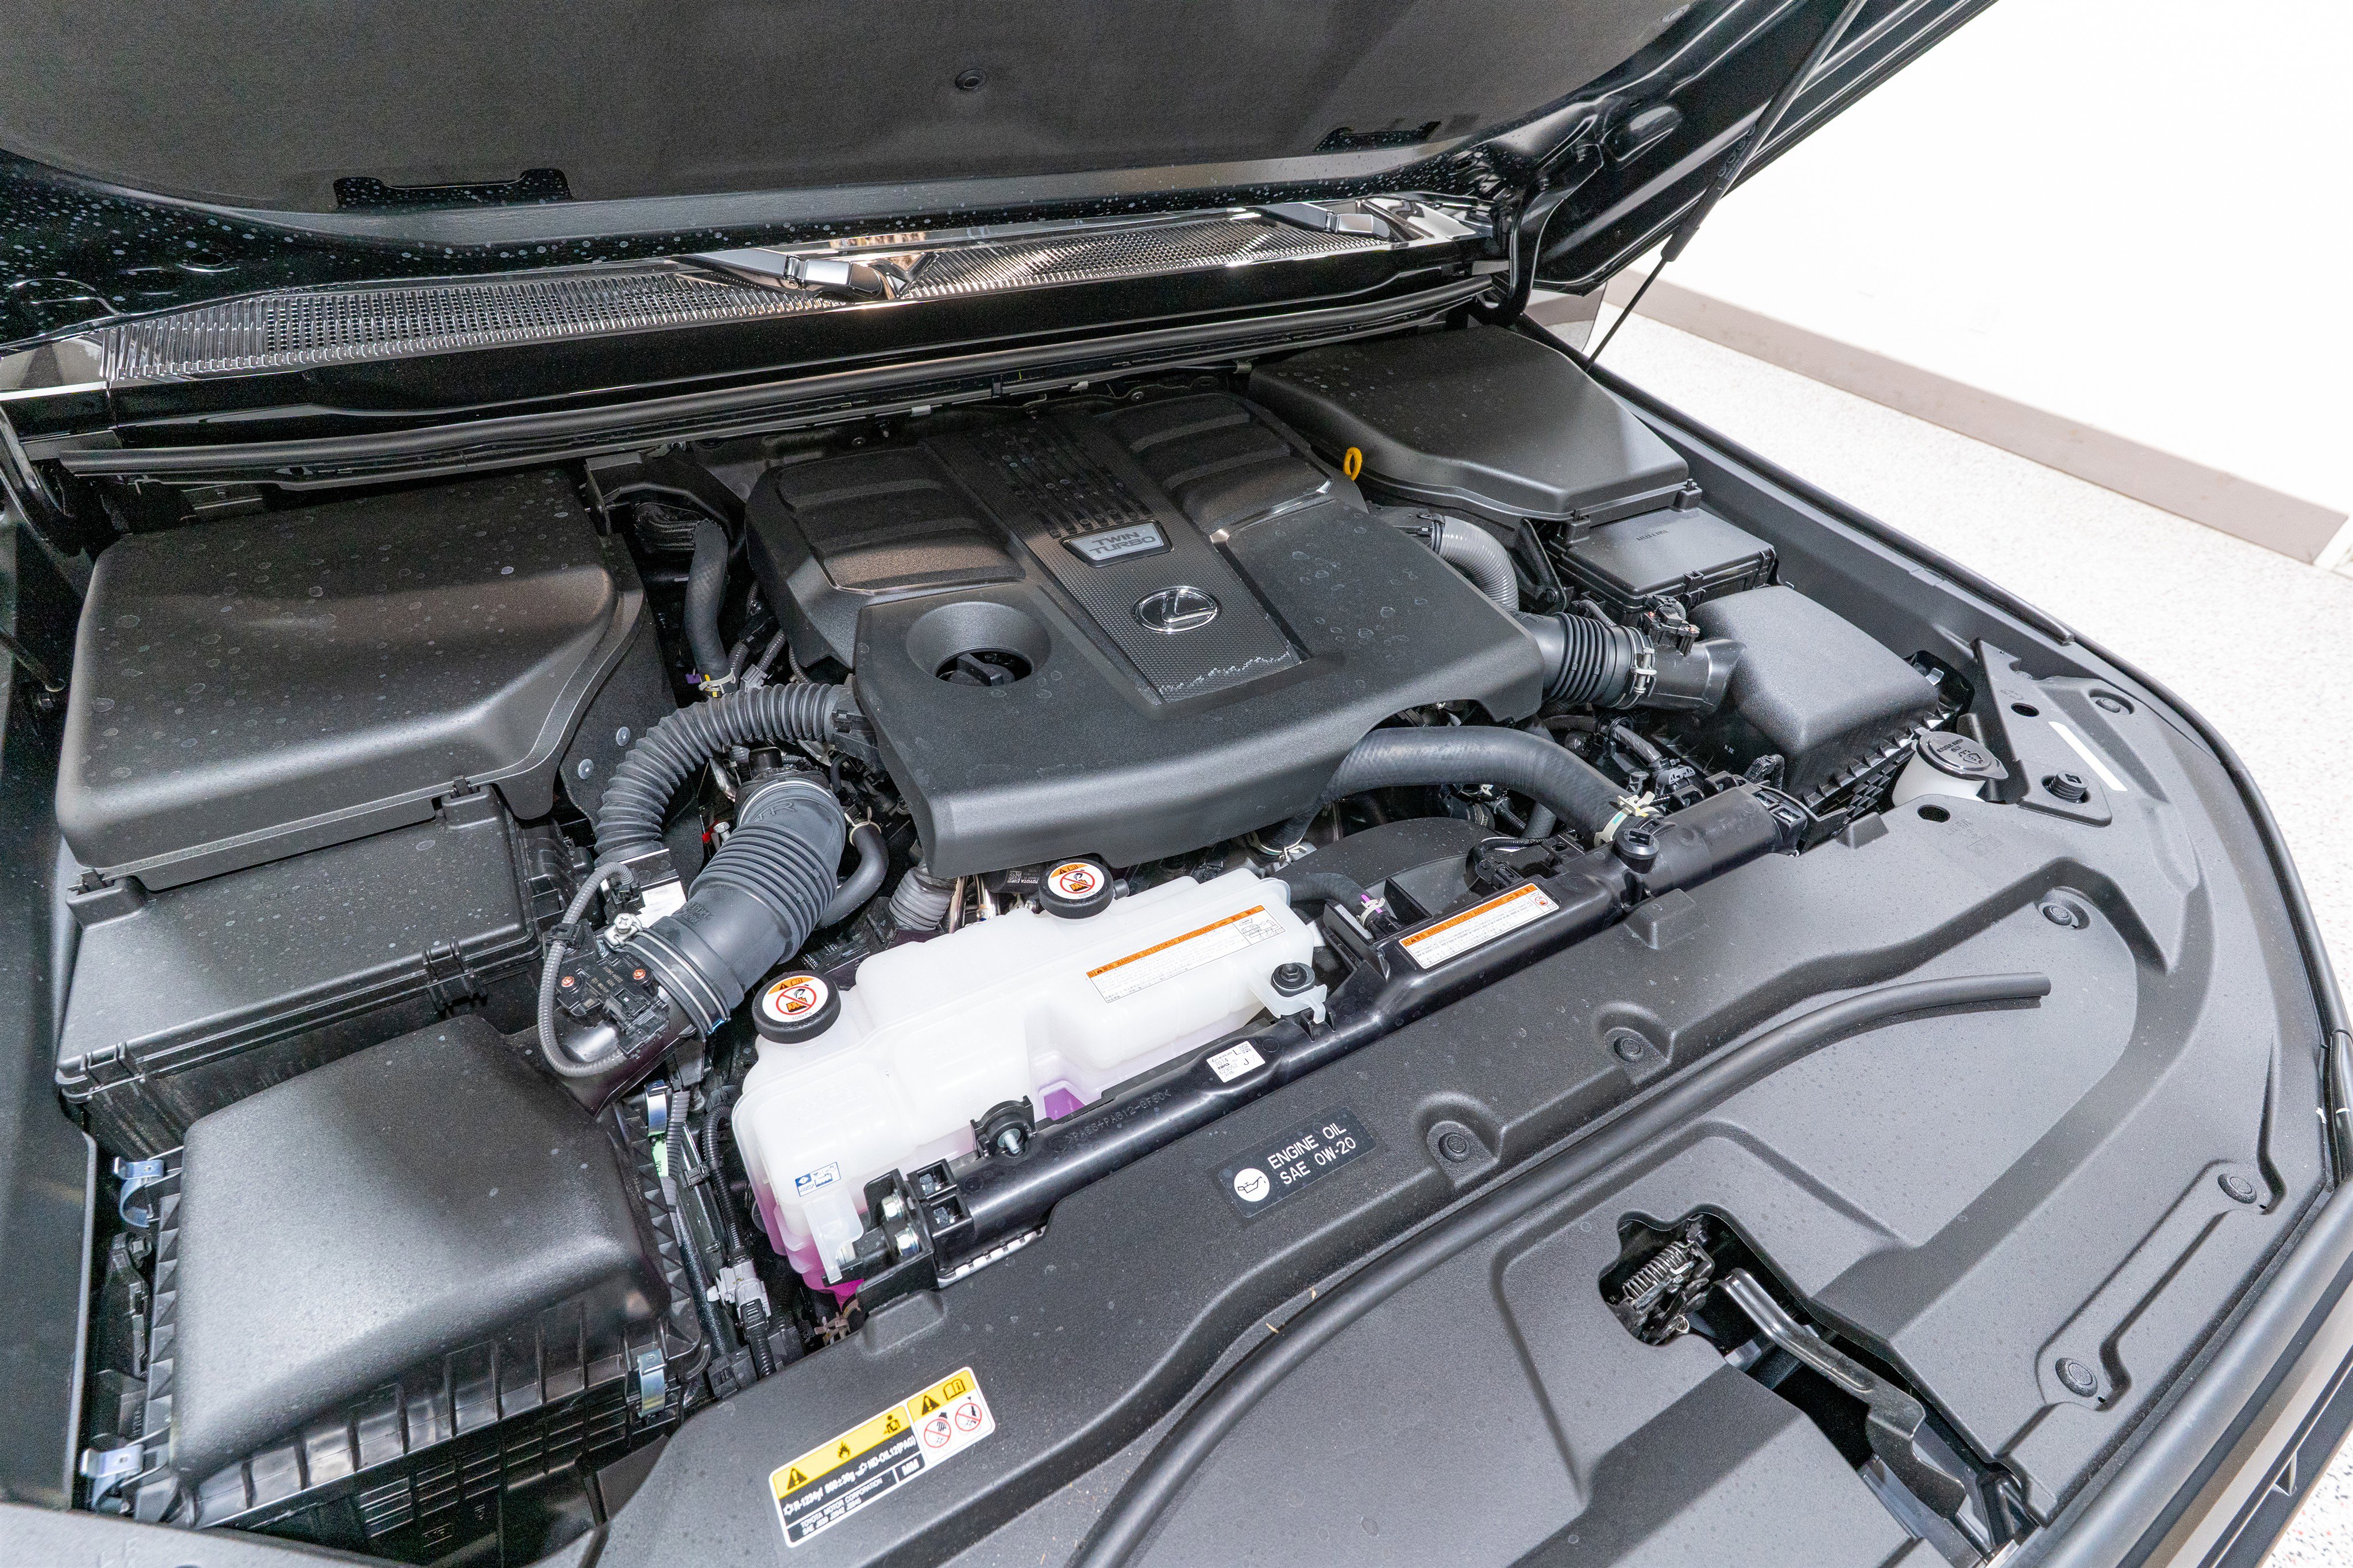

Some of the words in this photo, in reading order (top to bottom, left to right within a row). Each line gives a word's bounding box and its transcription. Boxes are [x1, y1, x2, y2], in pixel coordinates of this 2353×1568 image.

[1089, 536, 1156, 554] TURBO
[1091, 531, 1140, 546] TWIN
[1426, 924, 1446, 936] WARNING
[1473, 899, 1503, 916] AVERTISSEMENT
[1116, 953, 1140, 967] WARNING
[1178, 923, 1217, 943] AVERTISSEMENT
[1267, 1135, 1319, 1169] ENGINE
[1322, 1123, 1347, 1140] OIL
[1280, 1161, 1310, 1184] SAE
[1314, 1137, 1356, 1166] 0W-20
[800, 1512, 823, 1528] TOYOTA
[823, 1499, 844, 1515] MOTOR
[844, 1477, 883, 1504] CORPORATION
